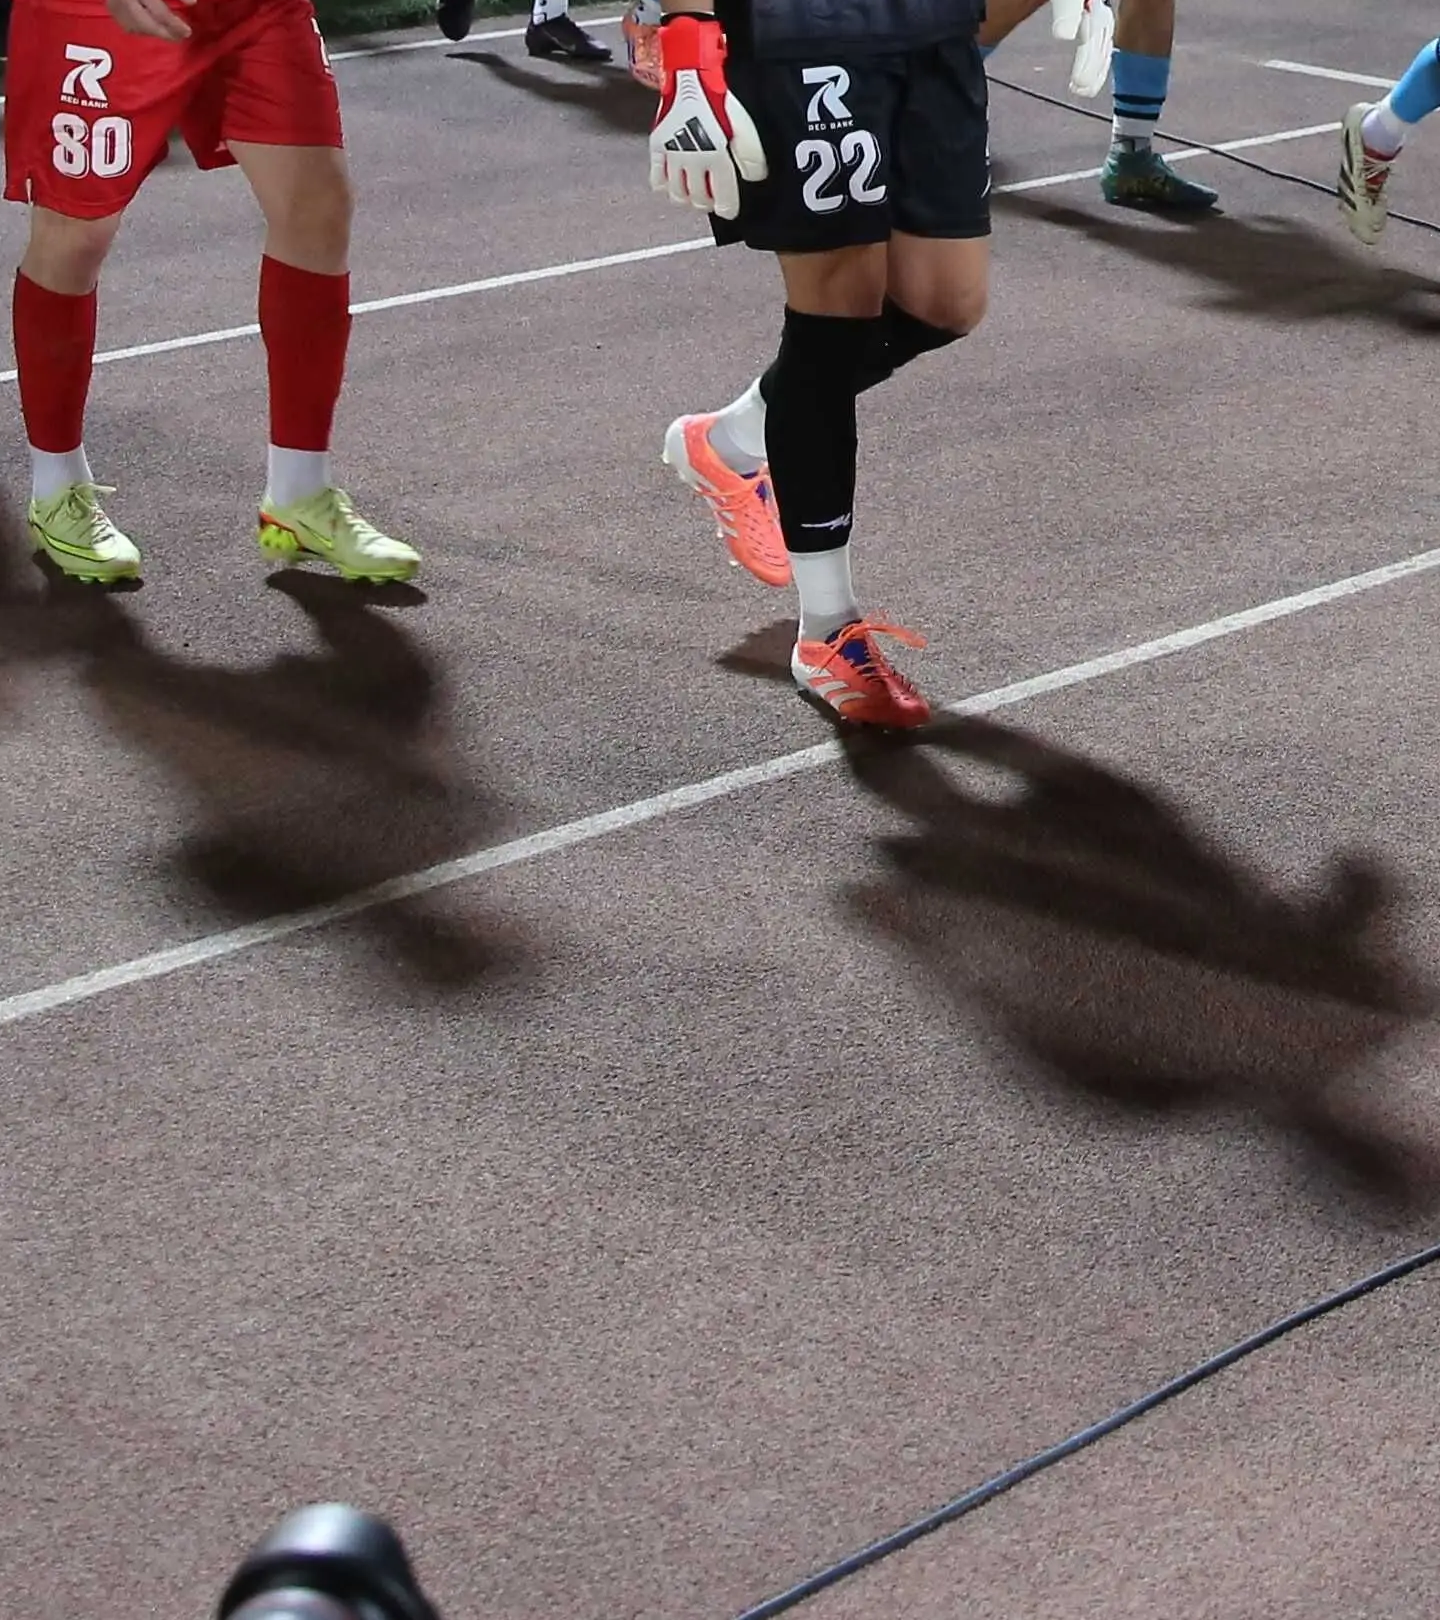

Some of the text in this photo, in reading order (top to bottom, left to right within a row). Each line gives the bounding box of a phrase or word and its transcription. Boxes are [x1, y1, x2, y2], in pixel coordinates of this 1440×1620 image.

[60, 94, 109, 109] RED BANK
[52, 111, 132, 180] 80
[809, 120, 854, 131] RED BANK
[795, 130, 888, 215] 22
